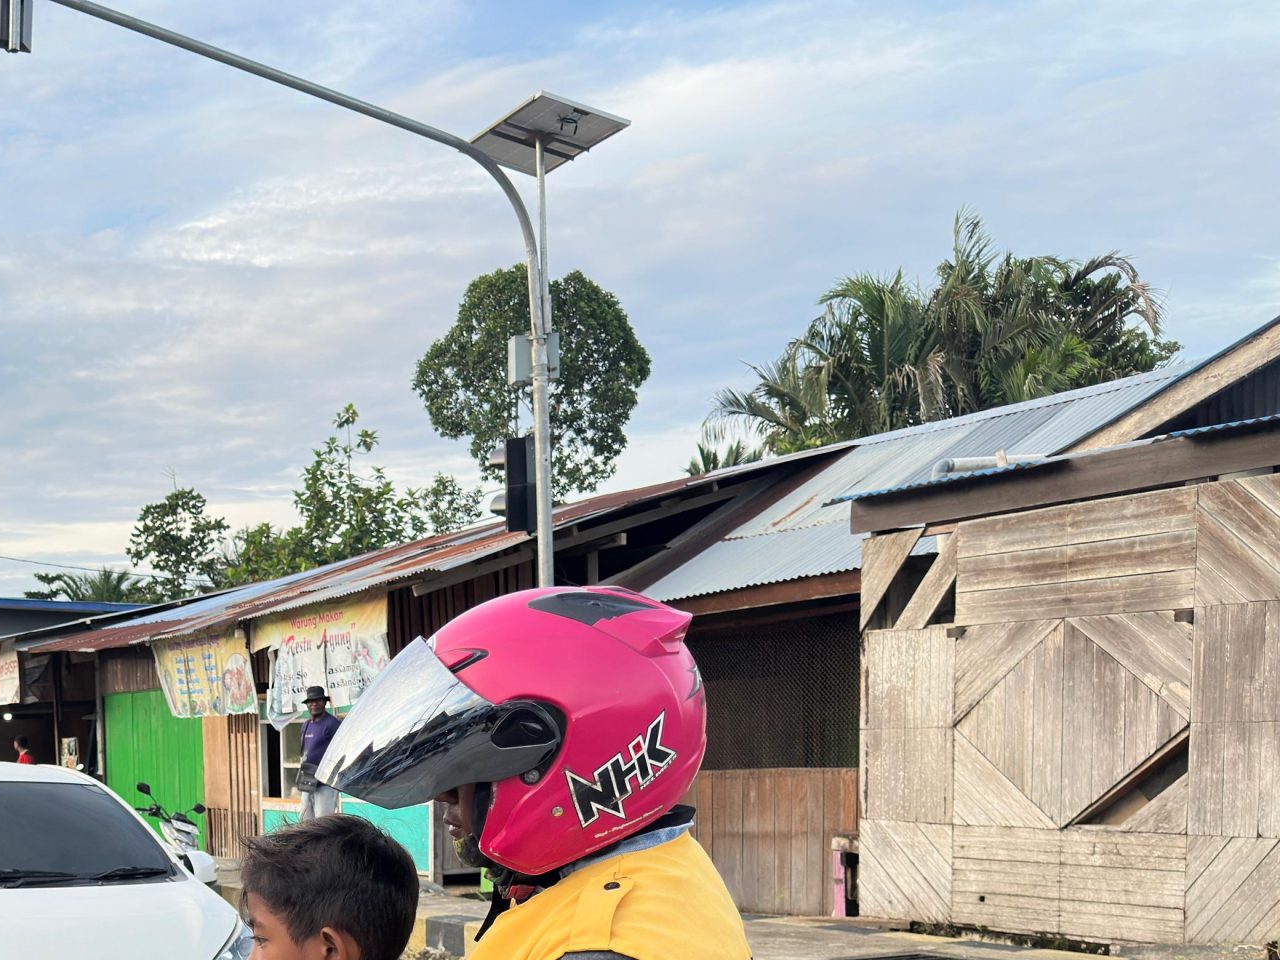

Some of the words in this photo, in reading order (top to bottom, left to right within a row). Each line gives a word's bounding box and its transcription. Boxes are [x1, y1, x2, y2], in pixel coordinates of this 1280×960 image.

[291, 616, 318, 630] Warung
[320, 609, 345, 623] Makan
[562, 708, 677, 830] NHK
